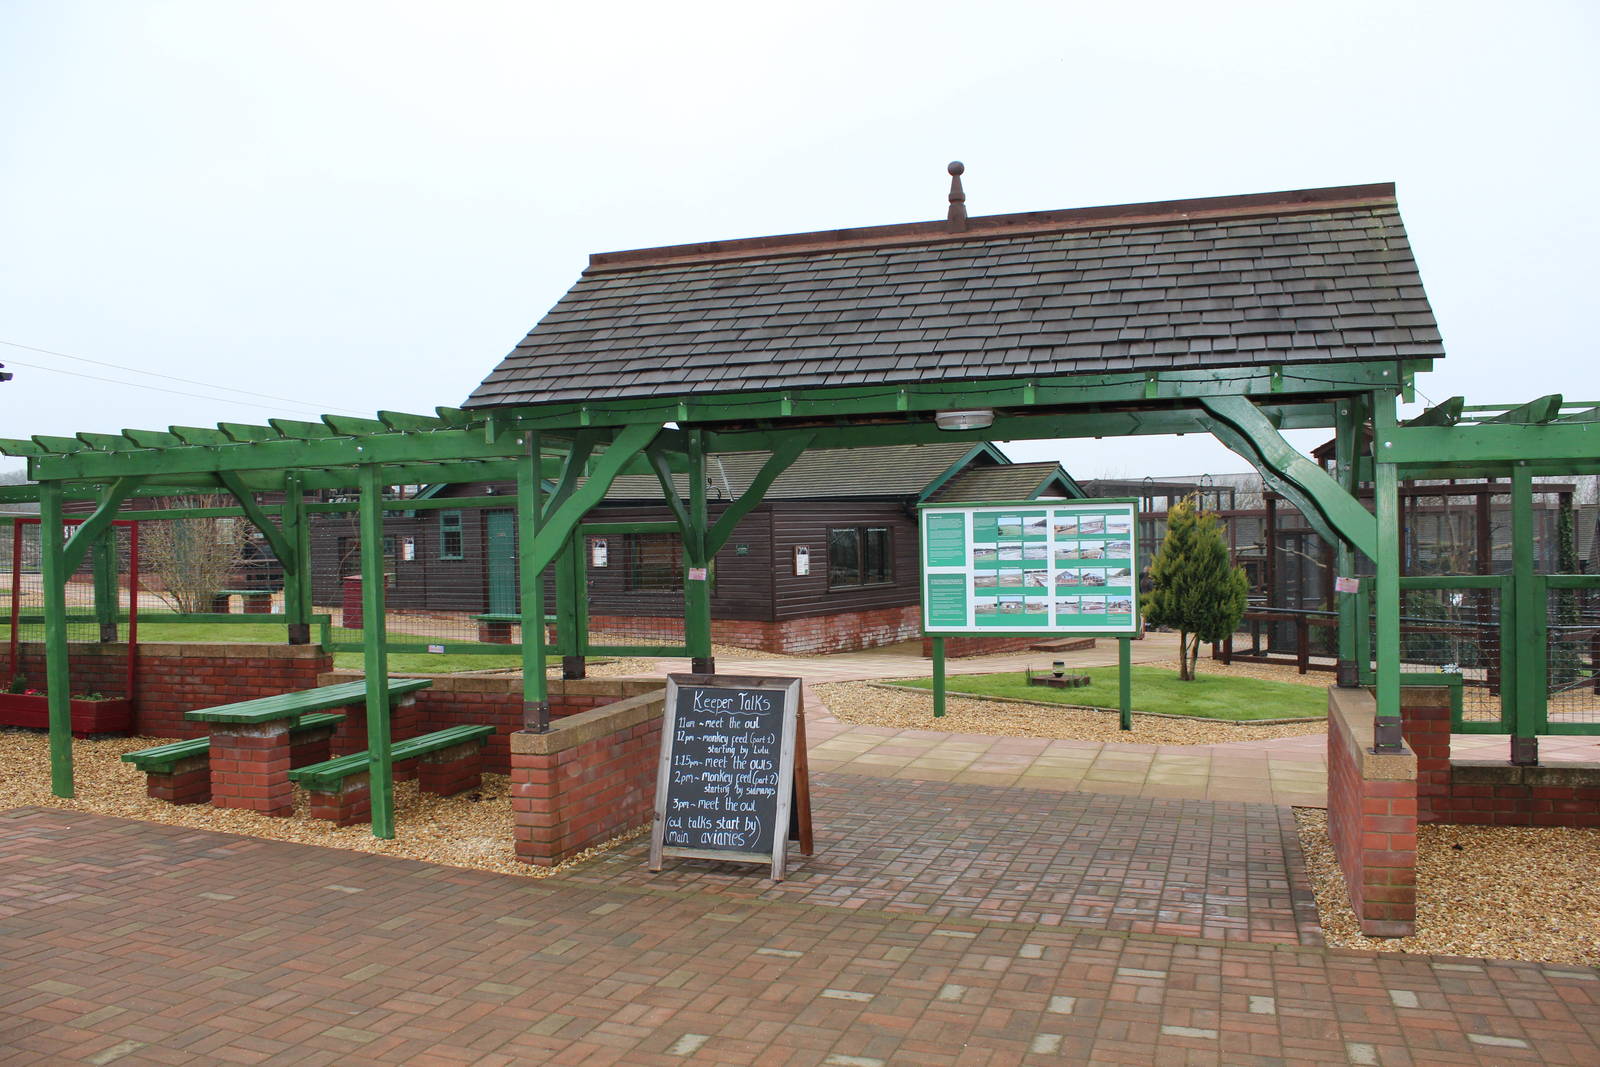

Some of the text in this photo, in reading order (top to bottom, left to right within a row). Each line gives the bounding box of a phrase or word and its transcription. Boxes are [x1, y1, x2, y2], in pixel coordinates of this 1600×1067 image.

[693, 690, 733, 715] Keeper
[678, 716, 760, 729] 11am meet the owl
[677, 731, 695, 744] 12pm
[702, 732, 728, 746] monkey
[732, 732, 748, 747] feed
[740, 745, 748, 760] by
[733, 756, 747, 770] the
[750, 759, 773, 770] owls
[674, 771, 694, 784] 2pm
[736, 770, 752, 786] feed
[672, 798, 690, 812] 3pm
[725, 797, 738, 812] the
[740, 800, 756, 812] owl
[688, 816, 712, 830] talks
[716, 816, 740, 830] start
